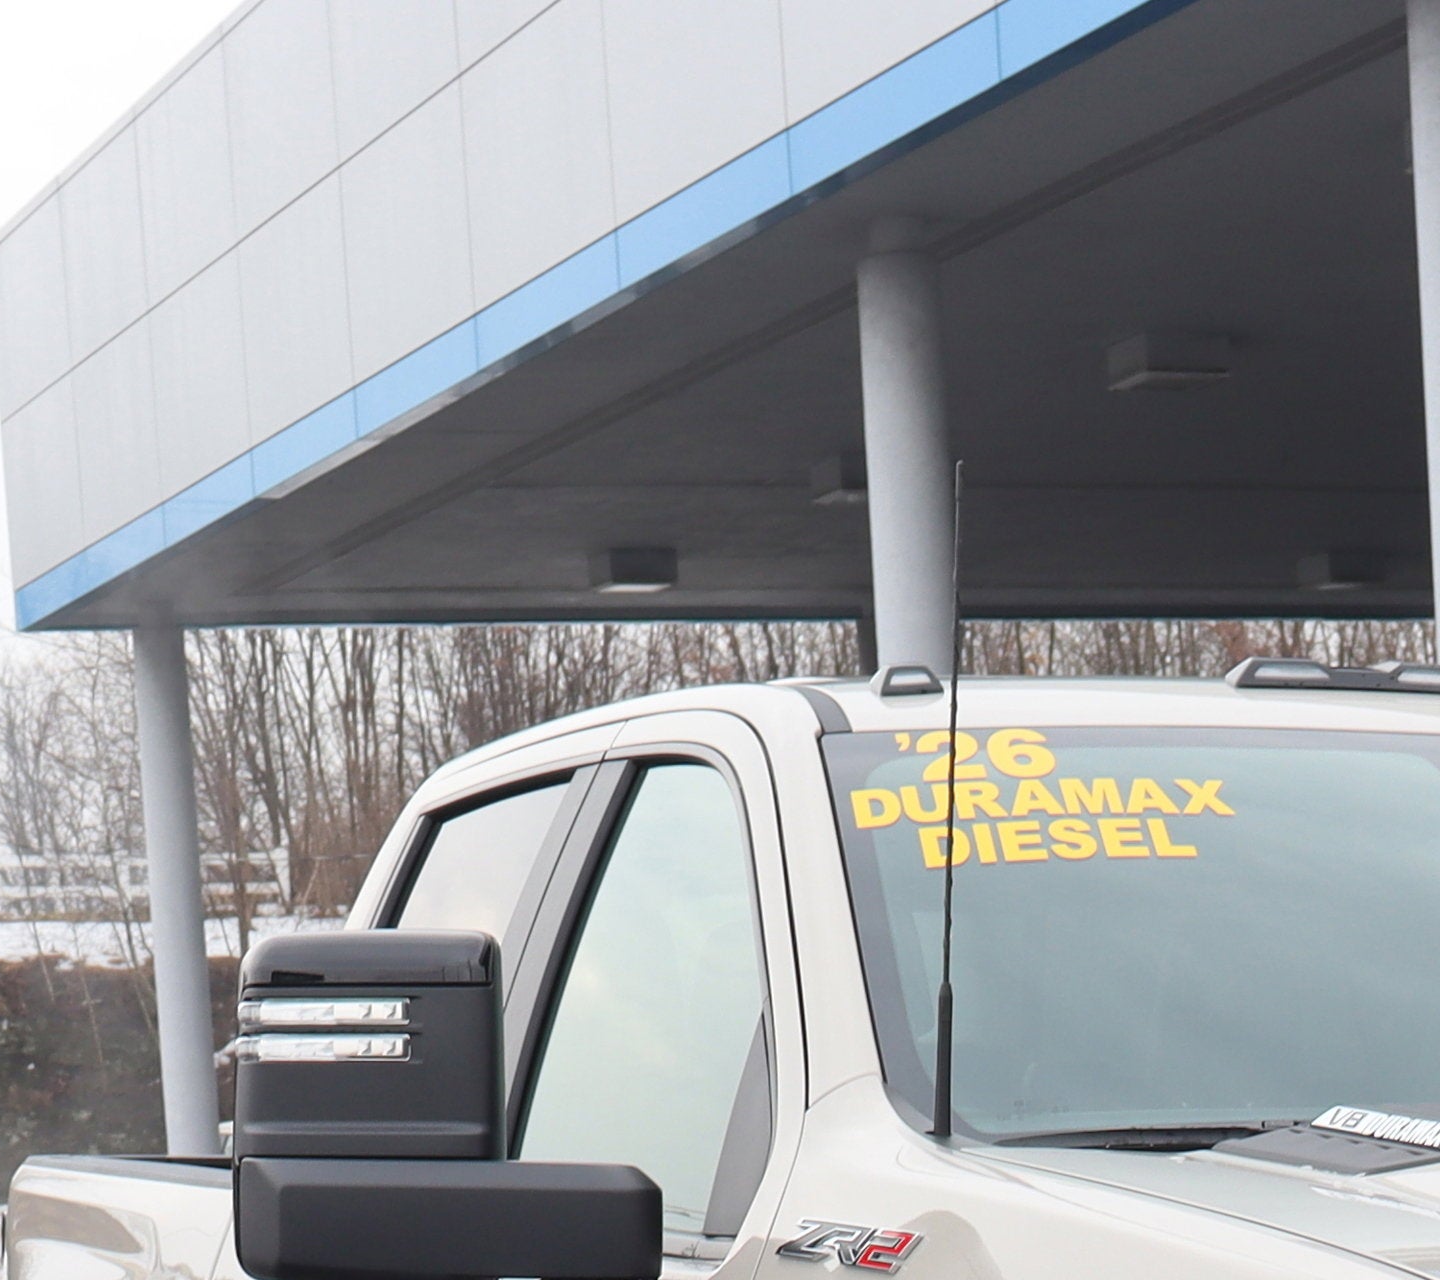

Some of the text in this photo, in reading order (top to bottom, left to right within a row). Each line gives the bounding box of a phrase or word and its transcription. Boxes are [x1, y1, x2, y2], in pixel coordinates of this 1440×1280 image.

[850, 778, 1237, 829] DURAMAX
[918, 817, 1199, 869] DIESEL
[1329, 1108, 1367, 1129] V8
[775, 1217, 925, 1276] ZR2
